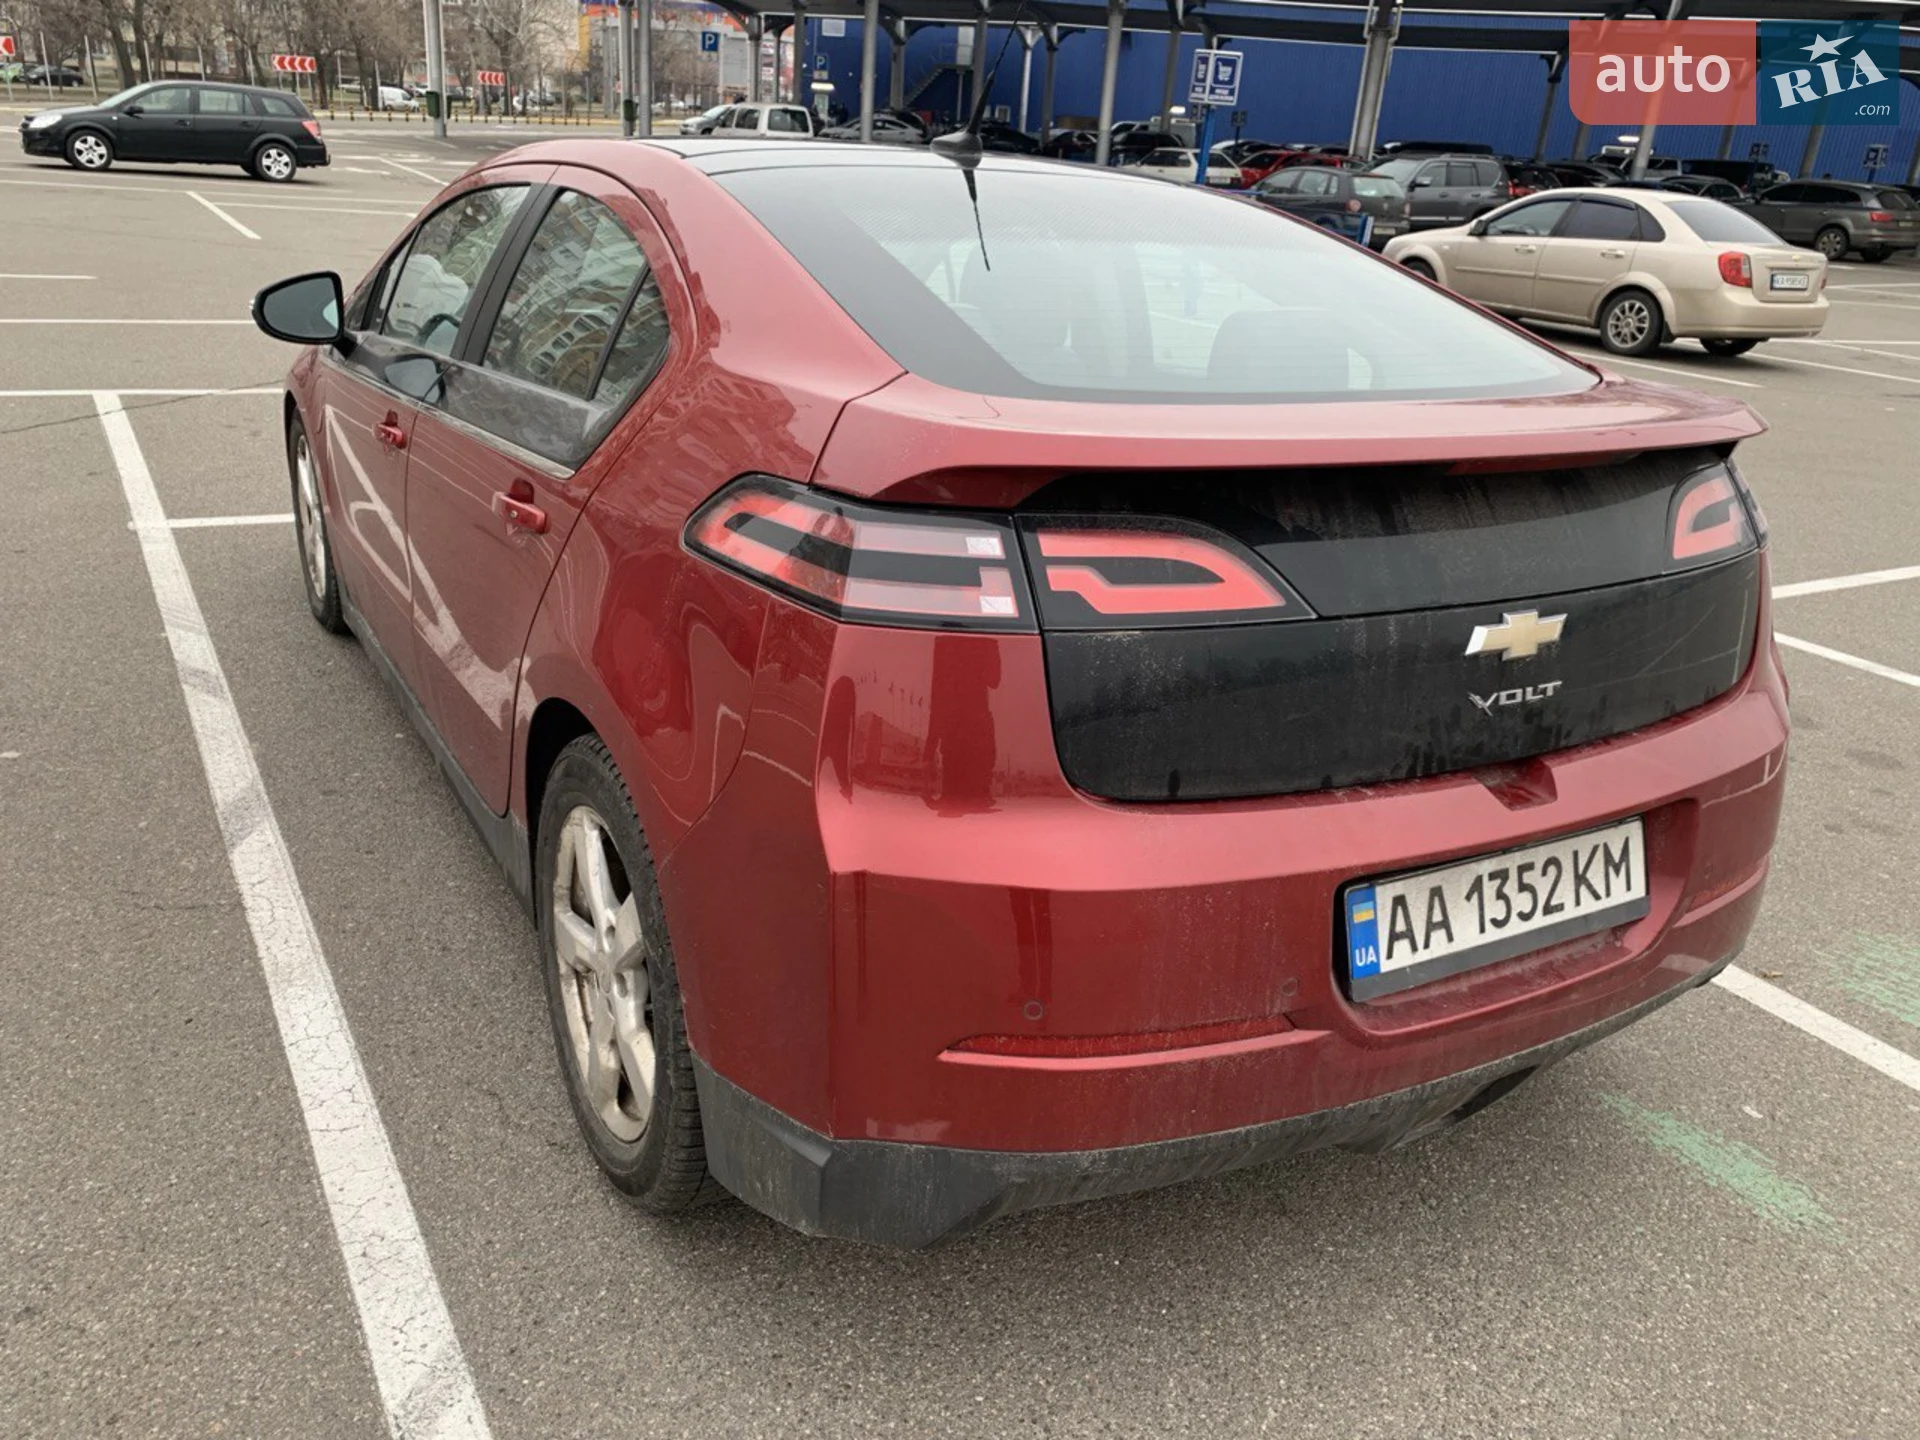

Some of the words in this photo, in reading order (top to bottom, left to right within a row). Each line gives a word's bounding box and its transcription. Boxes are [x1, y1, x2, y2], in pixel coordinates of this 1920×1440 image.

[705, 33, 715, 49] P
[1467, 680, 1563, 717] VOLT
[1386, 884, 1455, 960] AA
[1464, 856, 1565, 934] 1352
[1572, 836, 1632, 907] KM
[1355, 948, 1377, 966] UA
